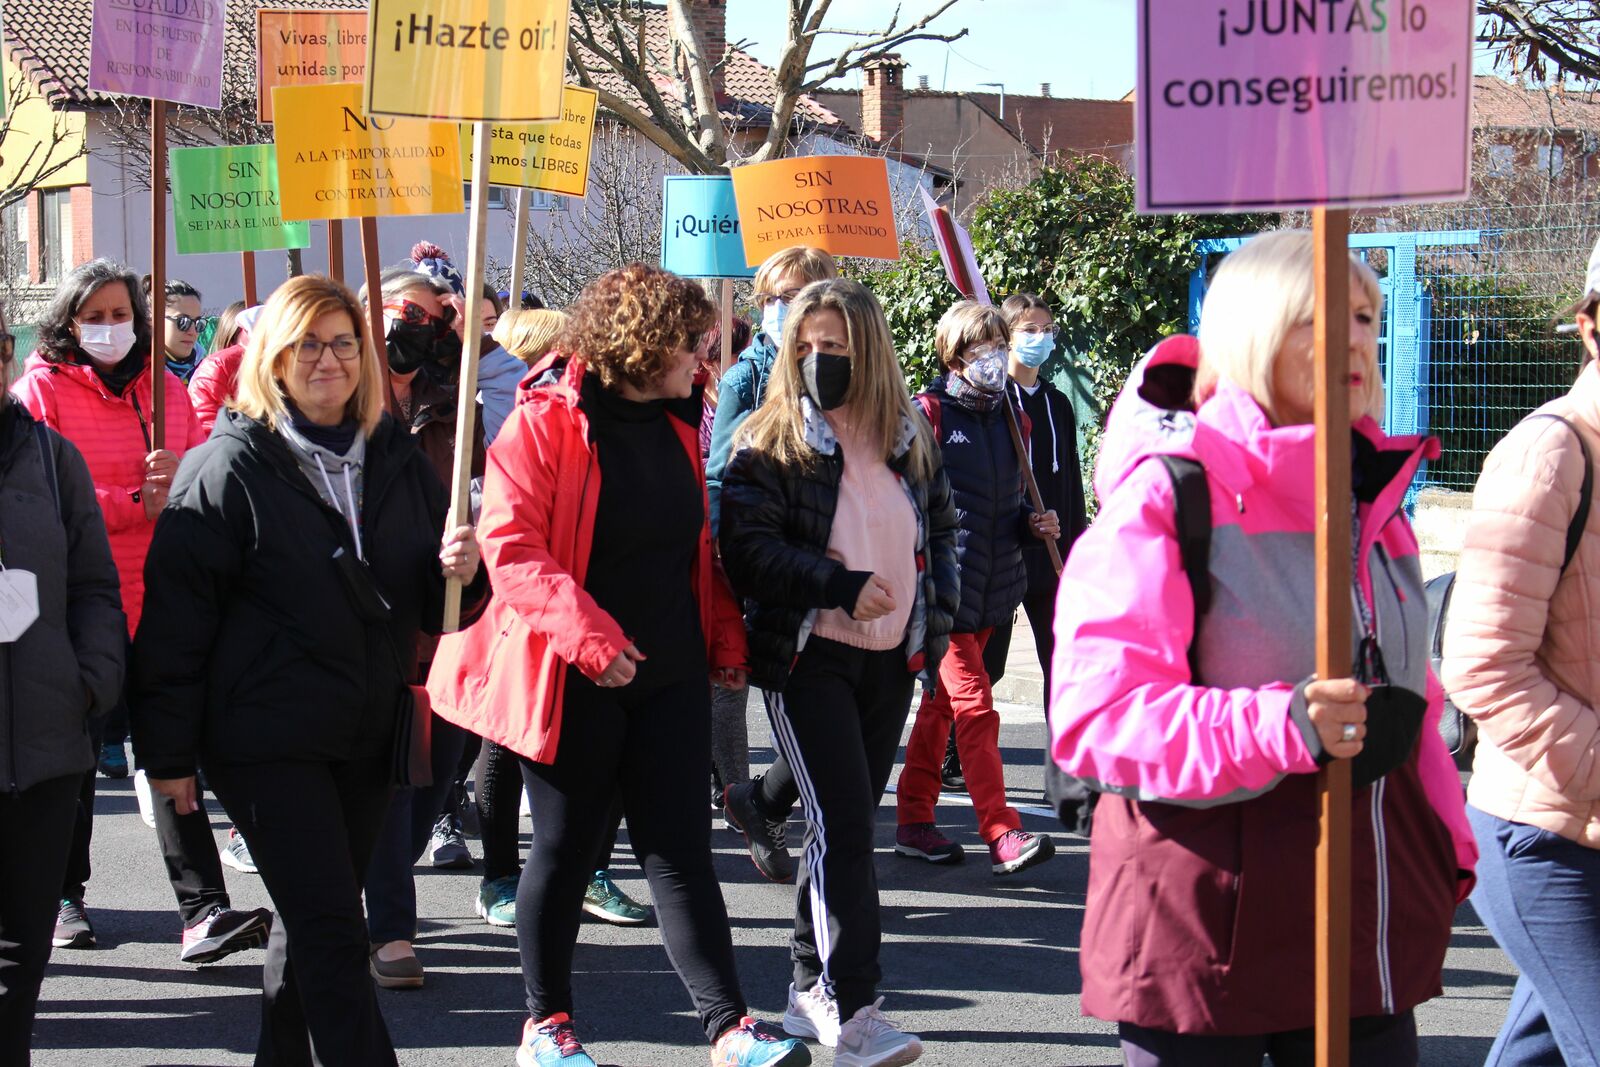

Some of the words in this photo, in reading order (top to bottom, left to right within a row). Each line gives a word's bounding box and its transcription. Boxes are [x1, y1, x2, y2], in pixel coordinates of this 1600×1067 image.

[115, 19, 132, 33] EN
[136, 20, 160, 36] LOS
[394, 13, 509, 52] ¡Hazte
[519, 20, 557, 51] oir!
[1218, 0, 1387, 46] ¡JUNTAS
[1401, 2, 1426, 32] lo
[279, 29, 331, 48] Vivas,
[157, 47, 173, 61] DE
[106, 61, 211, 88] RESPONSABILIDAD
[278, 60, 337, 76] unidas
[342, 64, 365, 80] por
[1163, 63, 1457, 113] conseguiremos!
[471, 123, 514, 140] sta
[518, 132, 545, 145] que
[549, 133, 582, 150] todas
[295, 151, 305, 164] A
[309, 151, 328, 162] LA
[331, 145, 445, 161] TEMPORALIDAD
[228, 161, 264, 179] SIN
[352, 168, 371, 181] EN
[376, 167, 394, 180] LA
[532, 156, 579, 175] LIBRES
[794, 170, 833, 188] SIN
[190, 190, 279, 210] NOSOTR
[315, 184, 432, 202] CONTRATACIÓN
[757, 198, 878, 222] NOSOTRAS
[188, 221, 203, 232] SE
[206, 219, 241, 231] PARA
[244, 218, 258, 229] EL
[757, 231, 773, 243] SE
[776, 226, 815, 240] PARA
[817, 224, 835, 235] EL
[837, 224, 887, 238] MUNDO
